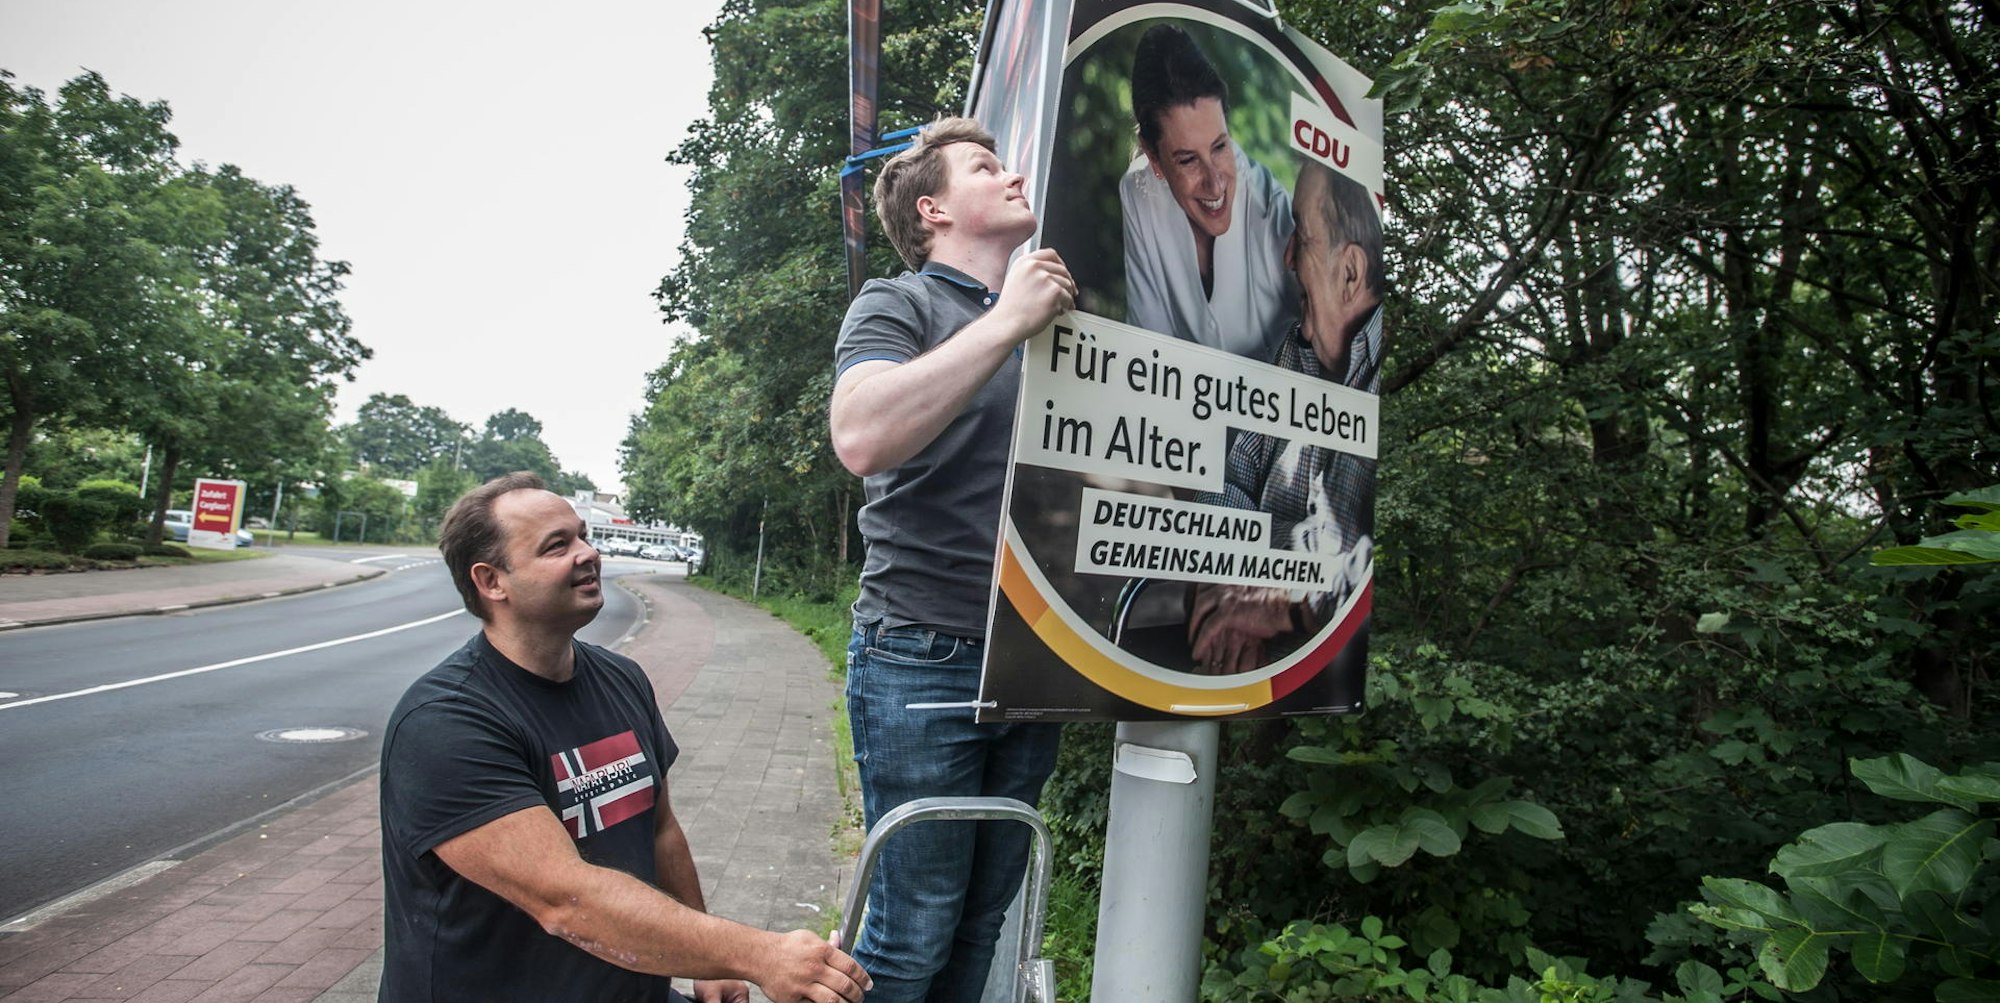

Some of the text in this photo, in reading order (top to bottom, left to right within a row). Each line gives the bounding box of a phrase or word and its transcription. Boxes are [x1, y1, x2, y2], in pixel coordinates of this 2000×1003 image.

[1294, 119, 1350, 169] CDU
[1050, 325, 1367, 444] Für ein gutes Leben
[1042, 399, 1206, 476] im Alter.
[1093, 500, 1262, 543] DEUTSCHLAND
[1090, 540, 1326, 584] GEMEINSAM MACHEN.
[571, 758, 633, 794] NAPAPIJRI
